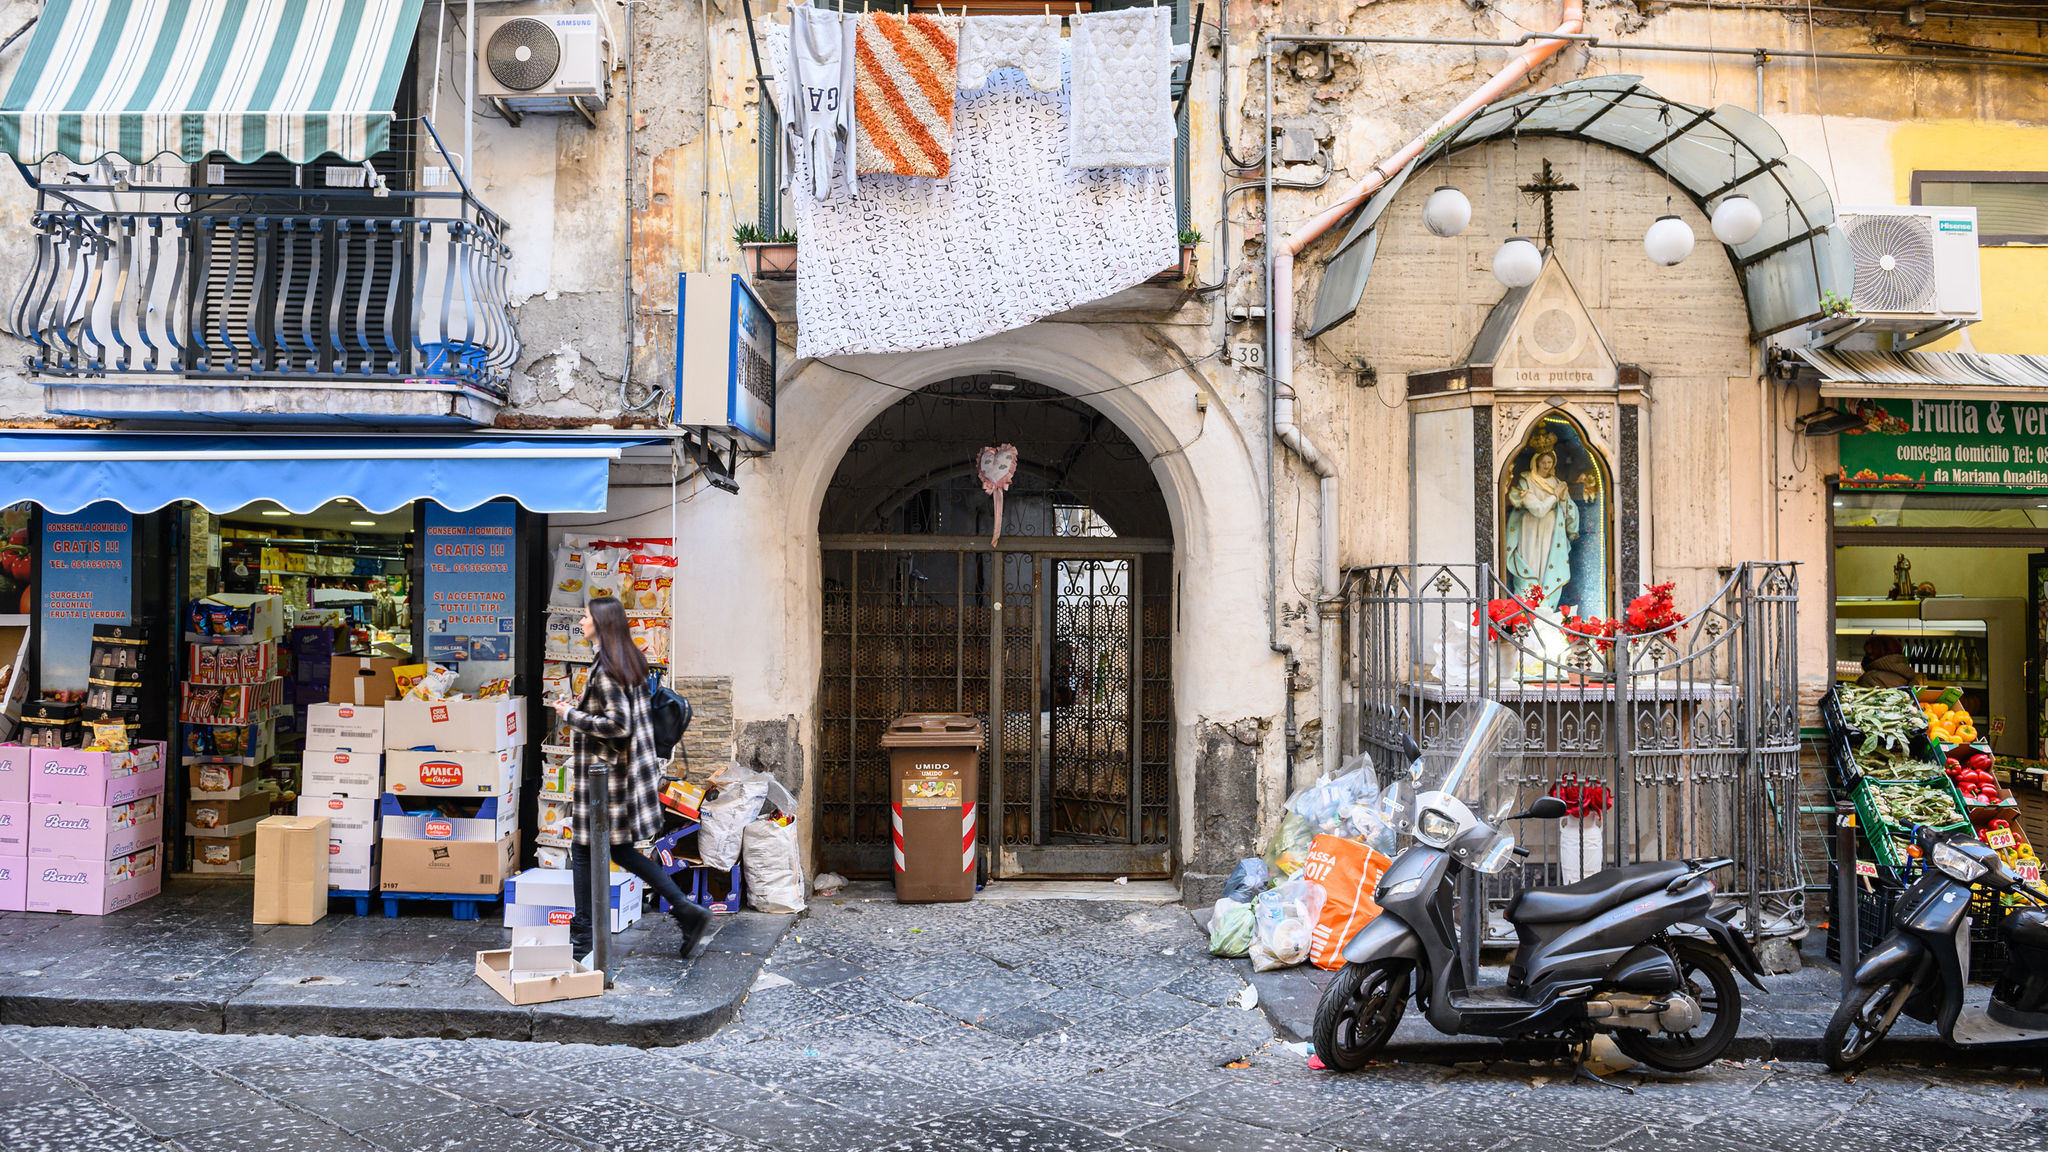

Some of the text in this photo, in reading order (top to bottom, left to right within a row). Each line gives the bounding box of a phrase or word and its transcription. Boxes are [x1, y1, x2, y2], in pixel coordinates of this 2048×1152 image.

[1940, 222, 1971, 230] Hisense
[1238, 348, 1259, 363] 38
[1911, 400, 1979, 434] Frutta
[1986, 401, 2006, 434] &
[1897, 444, 1951, 464] consegna
[1955, 444, 2010, 464] domicilio
[2012, 446, 2034, 464] Tel:
[1934, 468, 1949, 486] da
[1952, 468, 2000, 487] Mariano
[47, 523, 128, 532] CONSEGNA A DOMICILIO
[426, 526, 514, 536] CONSEGNA A DOMICILIO
[53, 540, 119, 552] GRATIS !!!
[434, 544, 505, 556] GRATIS !!!
[49, 560, 122, 568] TEL. 0813650773
[430, 564, 508, 572] TEL. 0813650773
[50, 591, 93, 599] SURGELATI
[434, 592, 506, 600] SI ACCETTANO
[440, 604, 469, 612] TUTTI
[480, 604, 500, 612] TIPI
[50, 610, 80, 618] FRUTTA
[90, 610, 126, 618] VERDURA
[448, 615, 494, 624] DI CARTE
[44, 760, 88, 777] Bauli
[421, 766, 462, 776] AMICA
[44, 814, 89, 830] Bauli
[427, 823, 450, 831] AMICA
[1992, 834, 2010, 846] 2.00
[42, 868, 88, 884] Bauli
[2018, 866, 2038, 880] 2.00
